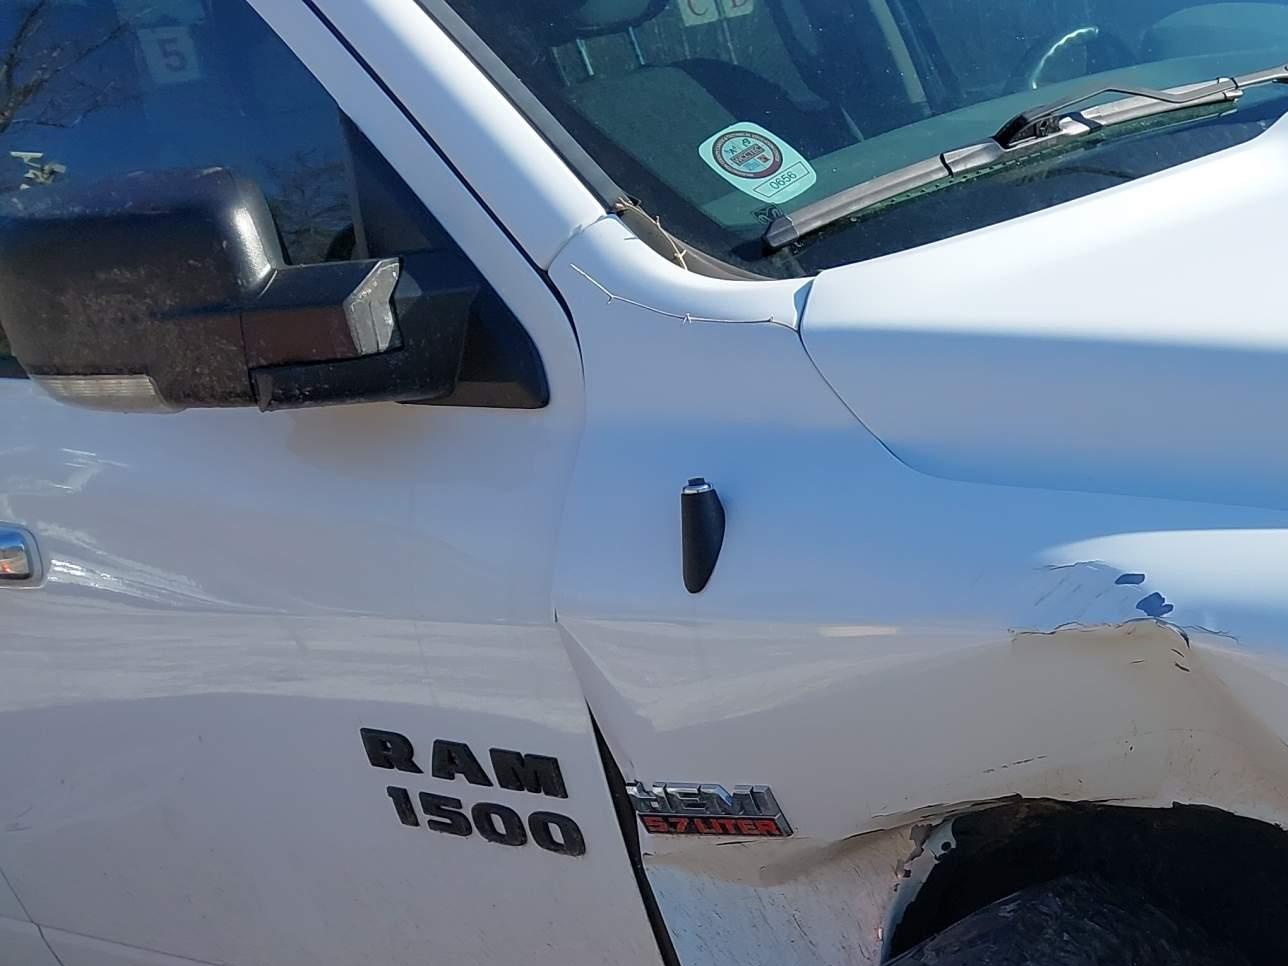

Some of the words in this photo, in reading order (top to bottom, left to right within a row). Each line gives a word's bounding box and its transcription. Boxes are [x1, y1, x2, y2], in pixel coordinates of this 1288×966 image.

[769, 170, 797, 190] 0656
[359, 727, 569, 799] RAM
[386, 785, 586, 857] 1500
[693, 817, 780, 834] LITER
